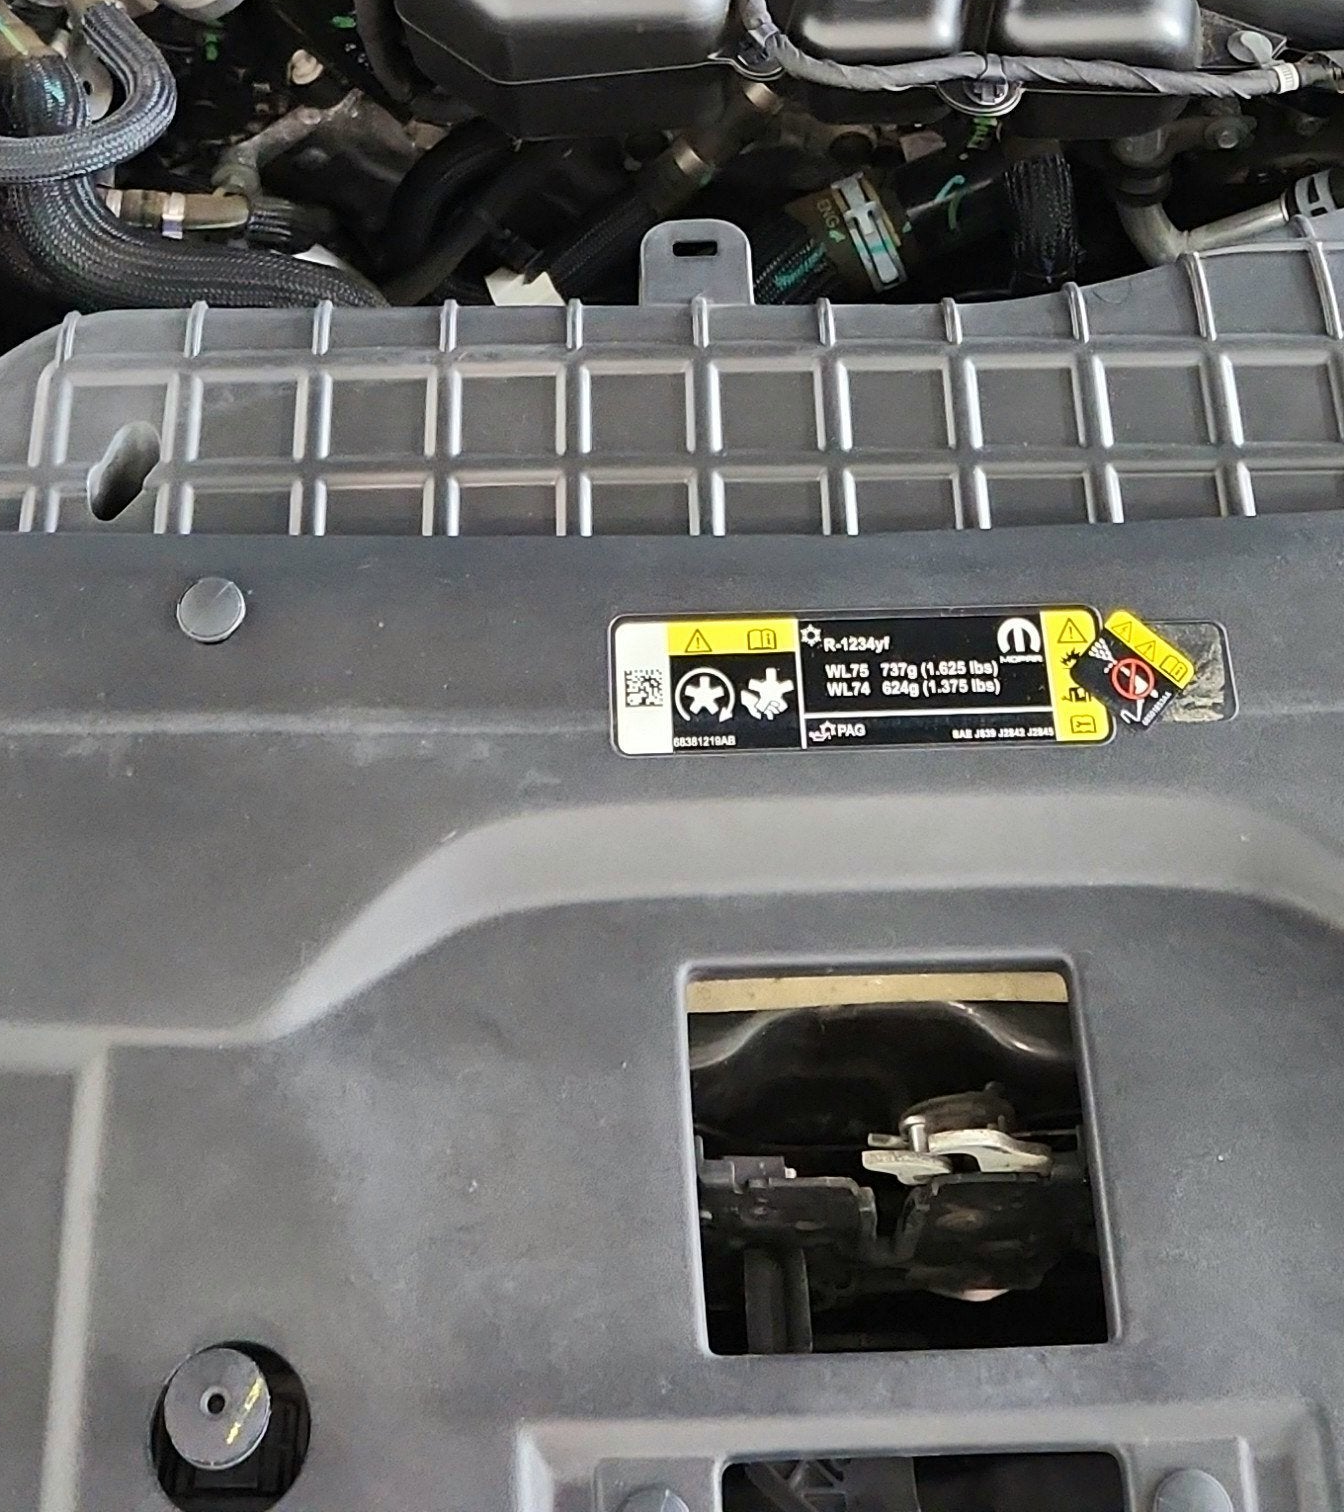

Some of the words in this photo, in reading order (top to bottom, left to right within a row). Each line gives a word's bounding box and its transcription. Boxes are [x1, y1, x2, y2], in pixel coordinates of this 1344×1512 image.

[823, 635, 891, 654] R-1234yf
[999, 654, 1043, 664] MOPAR
[825, 663, 870, 679] WL75
[880, 662, 918, 679] 737g
[920, 661, 967, 679] (1.625
[969, 660, 999, 677] lbs)
[826, 681, 871, 697] WL74
[881, 681, 920, 698] 624g
[922, 679, 969, 697] (1.375
[971, 678, 1001, 695] lbs)
[837, 723, 866, 737] PAG
